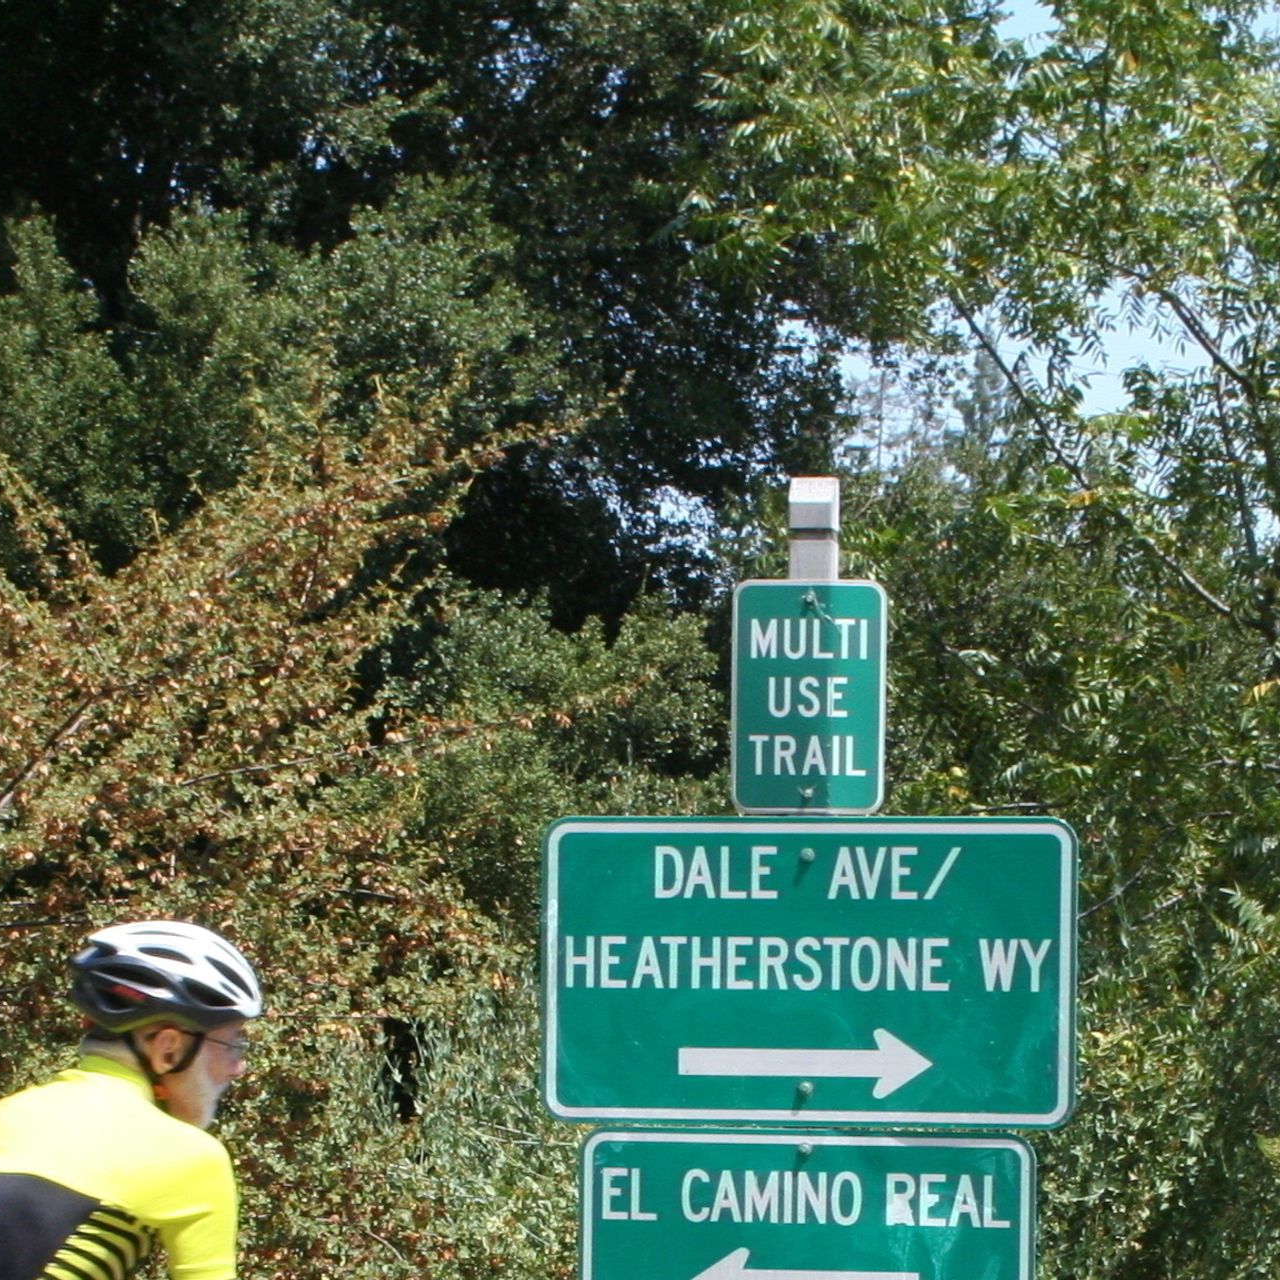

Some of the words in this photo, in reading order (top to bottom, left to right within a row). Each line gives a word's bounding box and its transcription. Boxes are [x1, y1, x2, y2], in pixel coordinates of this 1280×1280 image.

[748, 618, 869, 660] MULTI
[766, 676, 848, 718] USE
[748, 735, 867, 777] TRAIL
[653, 846, 778, 900] DALE
[827, 846, 962, 901] AVE/
[564, 936, 950, 993] HEATHERSTONE
[978, 938, 1052, 994] WY
[601, 1168, 657, 1222] EL
[680, 1169, 860, 1225] CAMINO
[885, 1173, 1011, 1229] REAL
